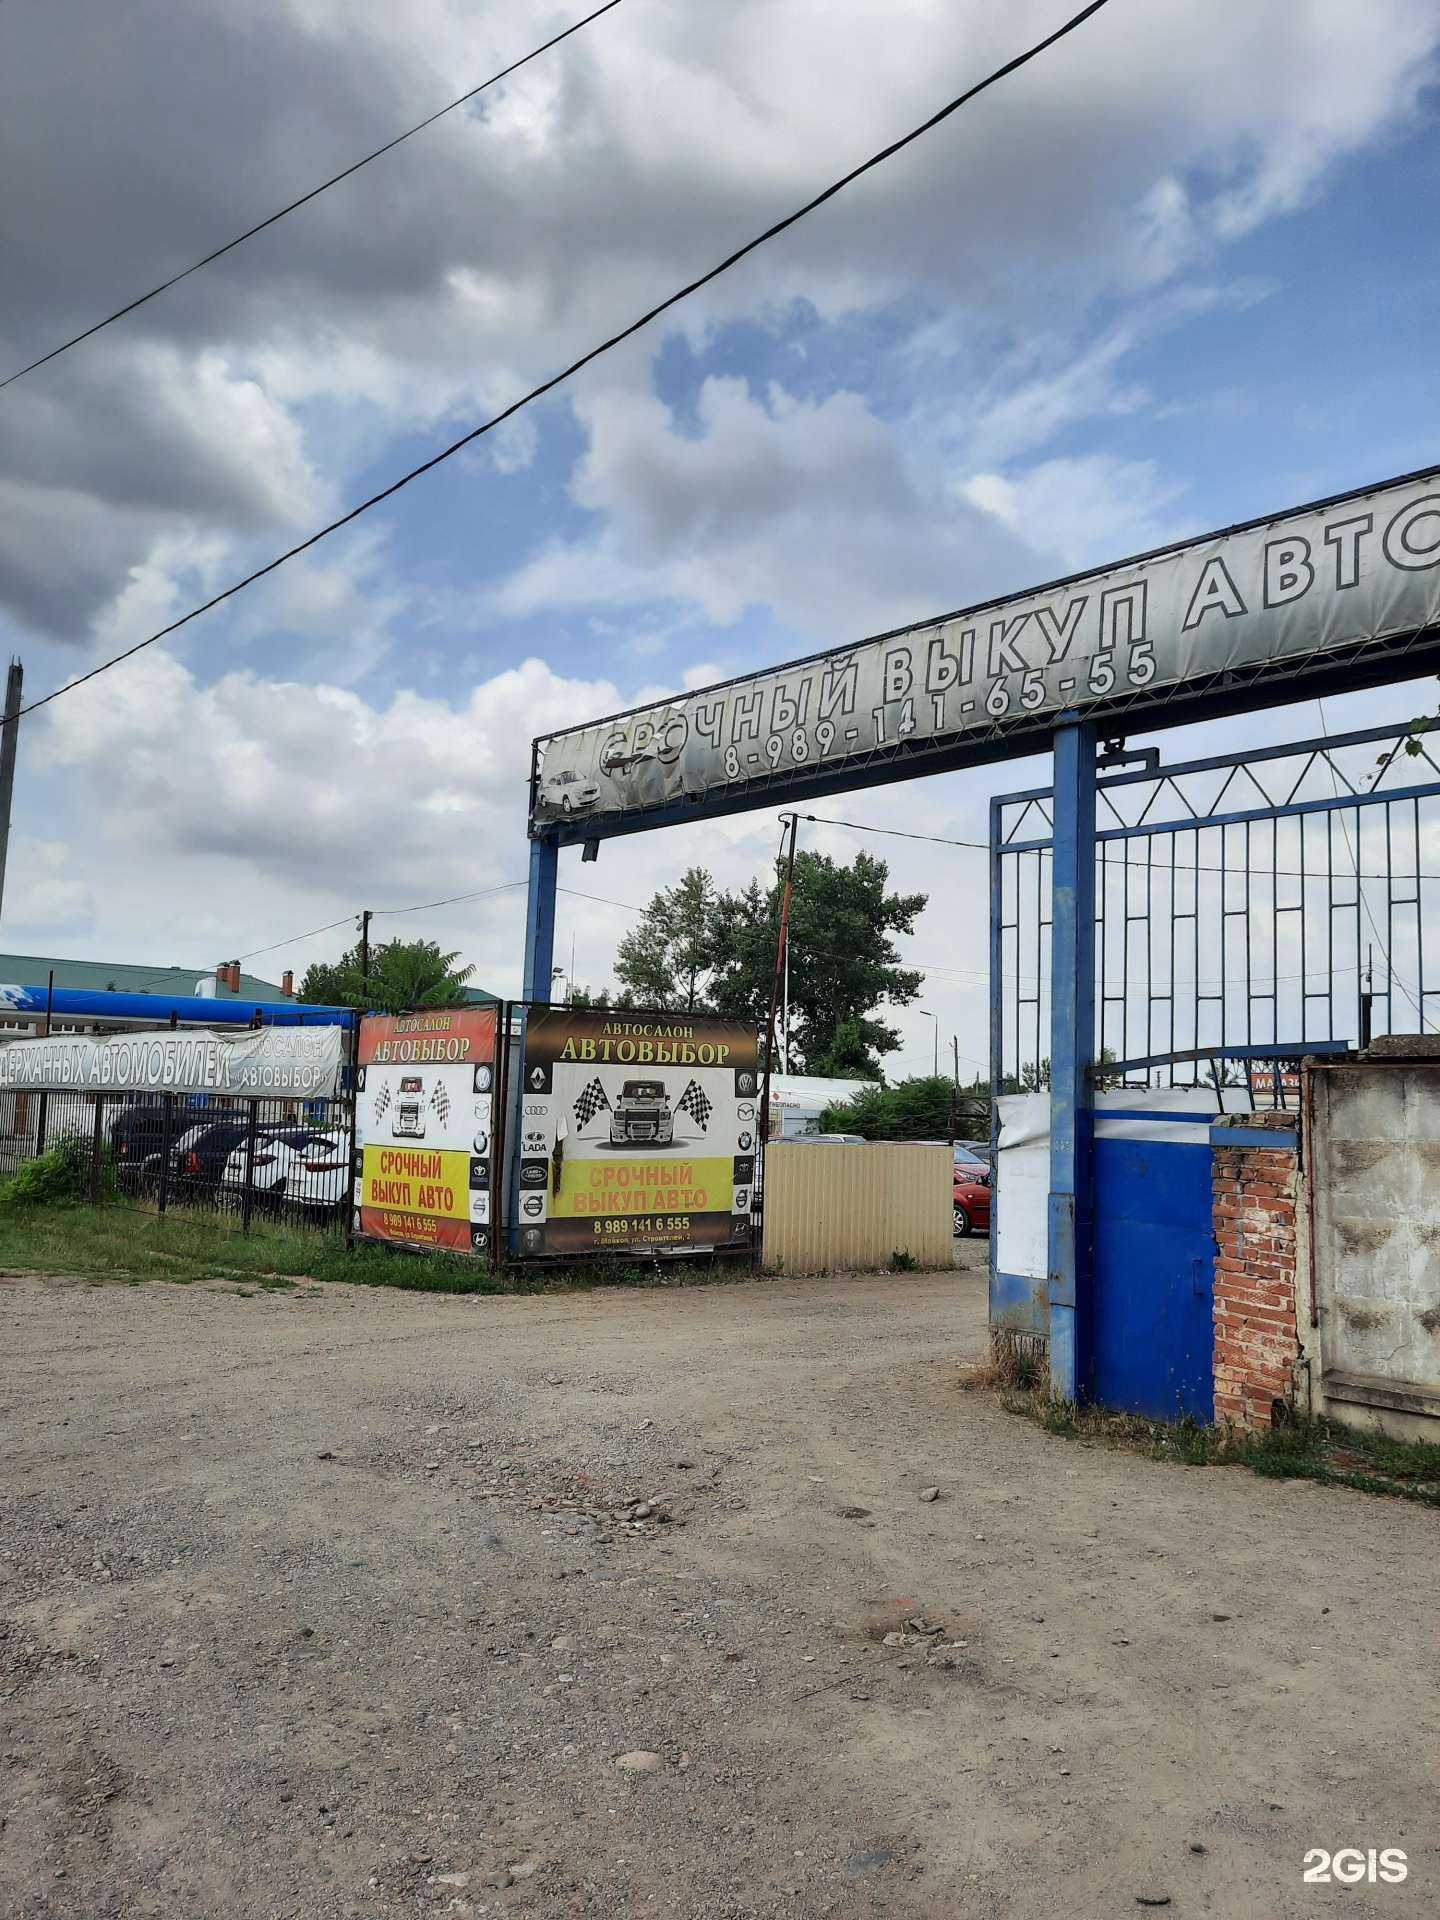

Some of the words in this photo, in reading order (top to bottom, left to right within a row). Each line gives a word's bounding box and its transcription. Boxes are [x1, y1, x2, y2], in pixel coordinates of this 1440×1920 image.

[600, 656, 859, 778] СРОЧНЫЙ
[883, 579, 1148, 705] ВЫКУП
[1182, 493, 1440, 633] АВТО
[724, 640, 1157, 778] 8-989-141-65-55
[394, 1016, 452, 1033] АВТОСАЛОН
[602, 1022, 694, 1039] АВТОСАЛОН
[372, 1037, 471, 1063] АВТОВЫБОР
[559, 1036, 731, 1065] АВТОВЫБОР
[523, 1143, 547, 1152] LADA
[380, 1151, 442, 1180] СРОЧНЫЙ
[589, 1161, 694, 1189] СРОЧНЫЙ
[371, 1179, 412, 1206] ВЫКУП
[418, 1184, 454, 1212] АВТО
[573, 1190, 648, 1213] ВЫКУП
[652, 1187, 709, 1210] АВТО
[383, 1212, 389, 1225] 8
[389, 1213, 402, 1227] 989
[403, 1215, 416, 1229] 141
[416, 1217, 422, 1230] 6
[422, 1218, 437, 1232] 555
[593, 1220, 602, 1234] 8
[604, 1219, 629, 1234] 989
[631, 1218, 652, 1232] 141
[655, 1217, 664, 1231] 6
[666, 1216, 690, 1231] 555
